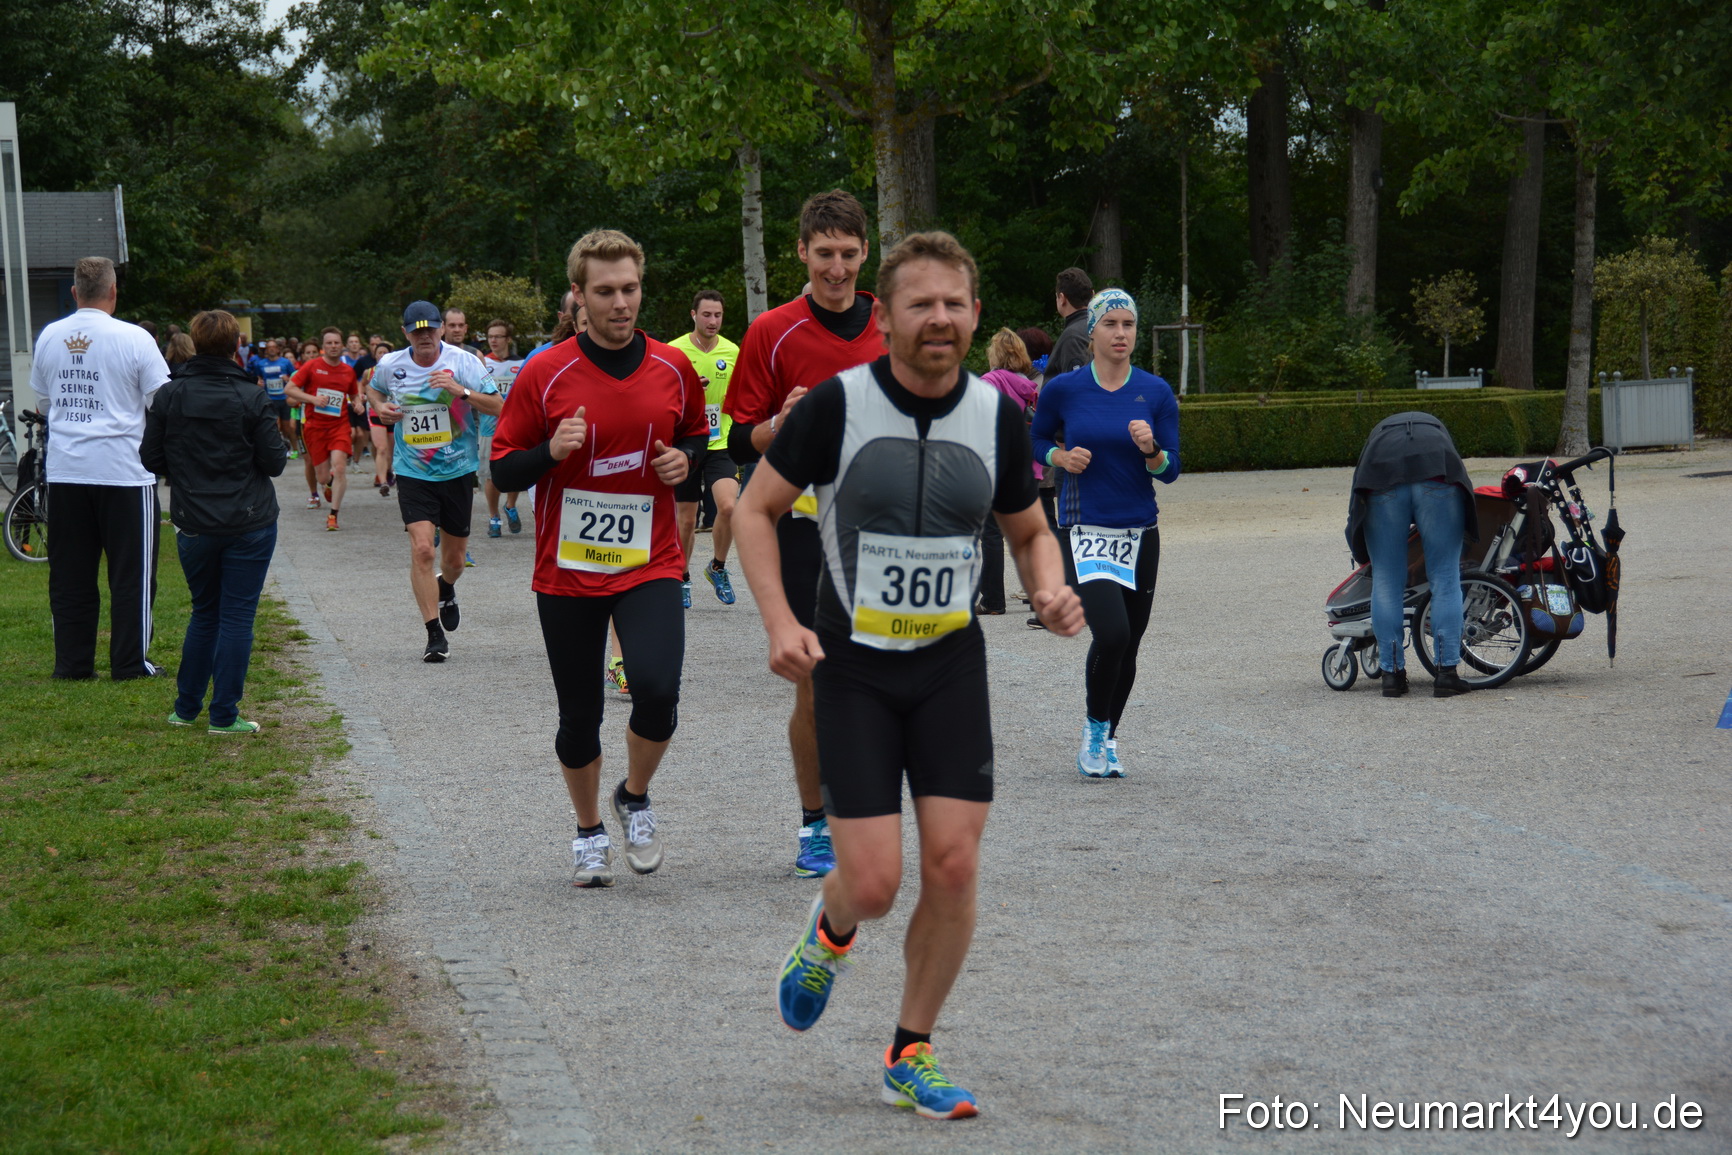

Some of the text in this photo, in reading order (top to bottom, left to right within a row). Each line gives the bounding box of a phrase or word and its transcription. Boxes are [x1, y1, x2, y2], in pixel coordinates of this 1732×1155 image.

[72, 355, 83, 365] IM
[61, 384, 94, 395] SEINER
[65, 412, 92, 423] JESUS
[411, 414, 439, 433] 341
[607, 459, 631, 470] DEHN
[564, 496, 638, 511] PARTL Neumarkt
[579, 511, 635, 544] 229
[585, 548, 622, 563] Martin
[862, 543, 960, 560] PARTL Neumarkt
[1080, 537, 1133, 565] 2242
[881, 565, 954, 608] 360
[891, 618, 938, 635] Oliver
